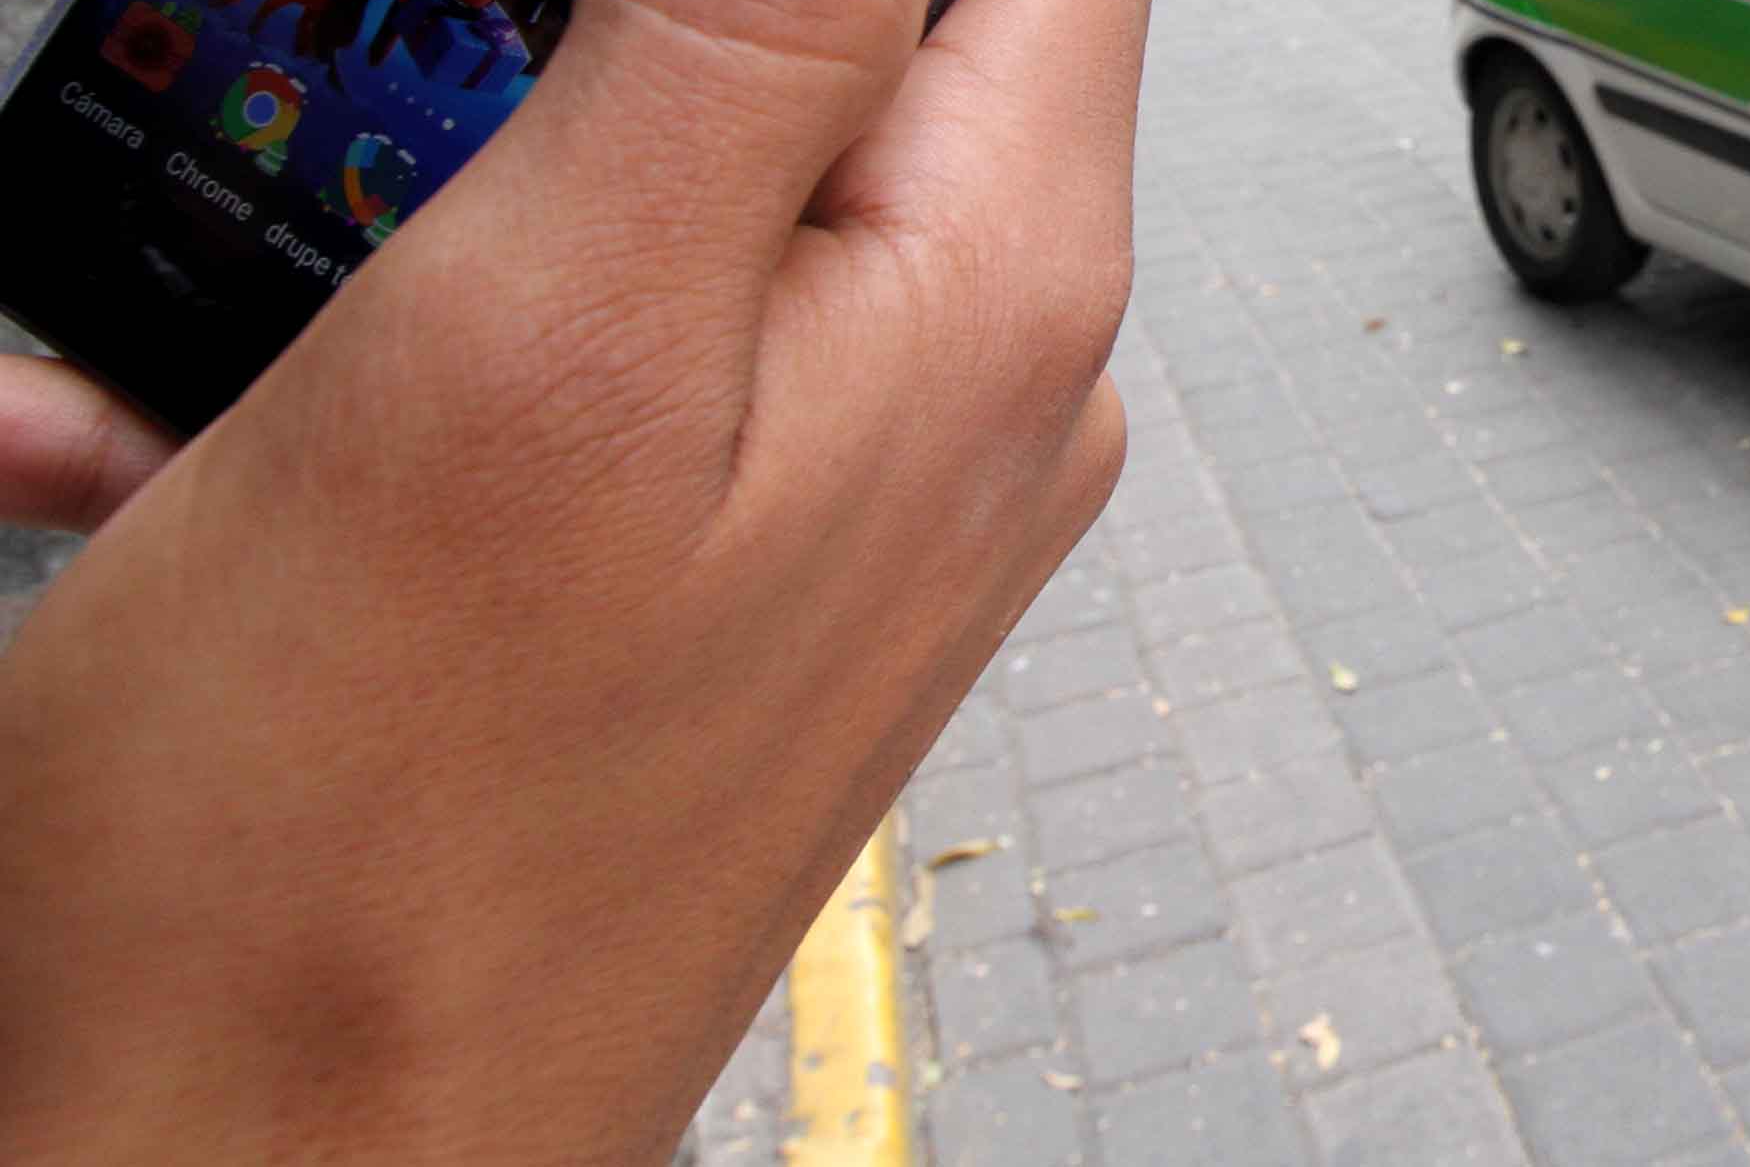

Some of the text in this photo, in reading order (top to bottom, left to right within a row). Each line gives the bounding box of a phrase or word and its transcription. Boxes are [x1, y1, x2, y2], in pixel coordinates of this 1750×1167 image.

[60, 81, 145, 150] Cámara
[166, 150, 255, 221] Chrome
[264, 220, 332, 275] drupe
